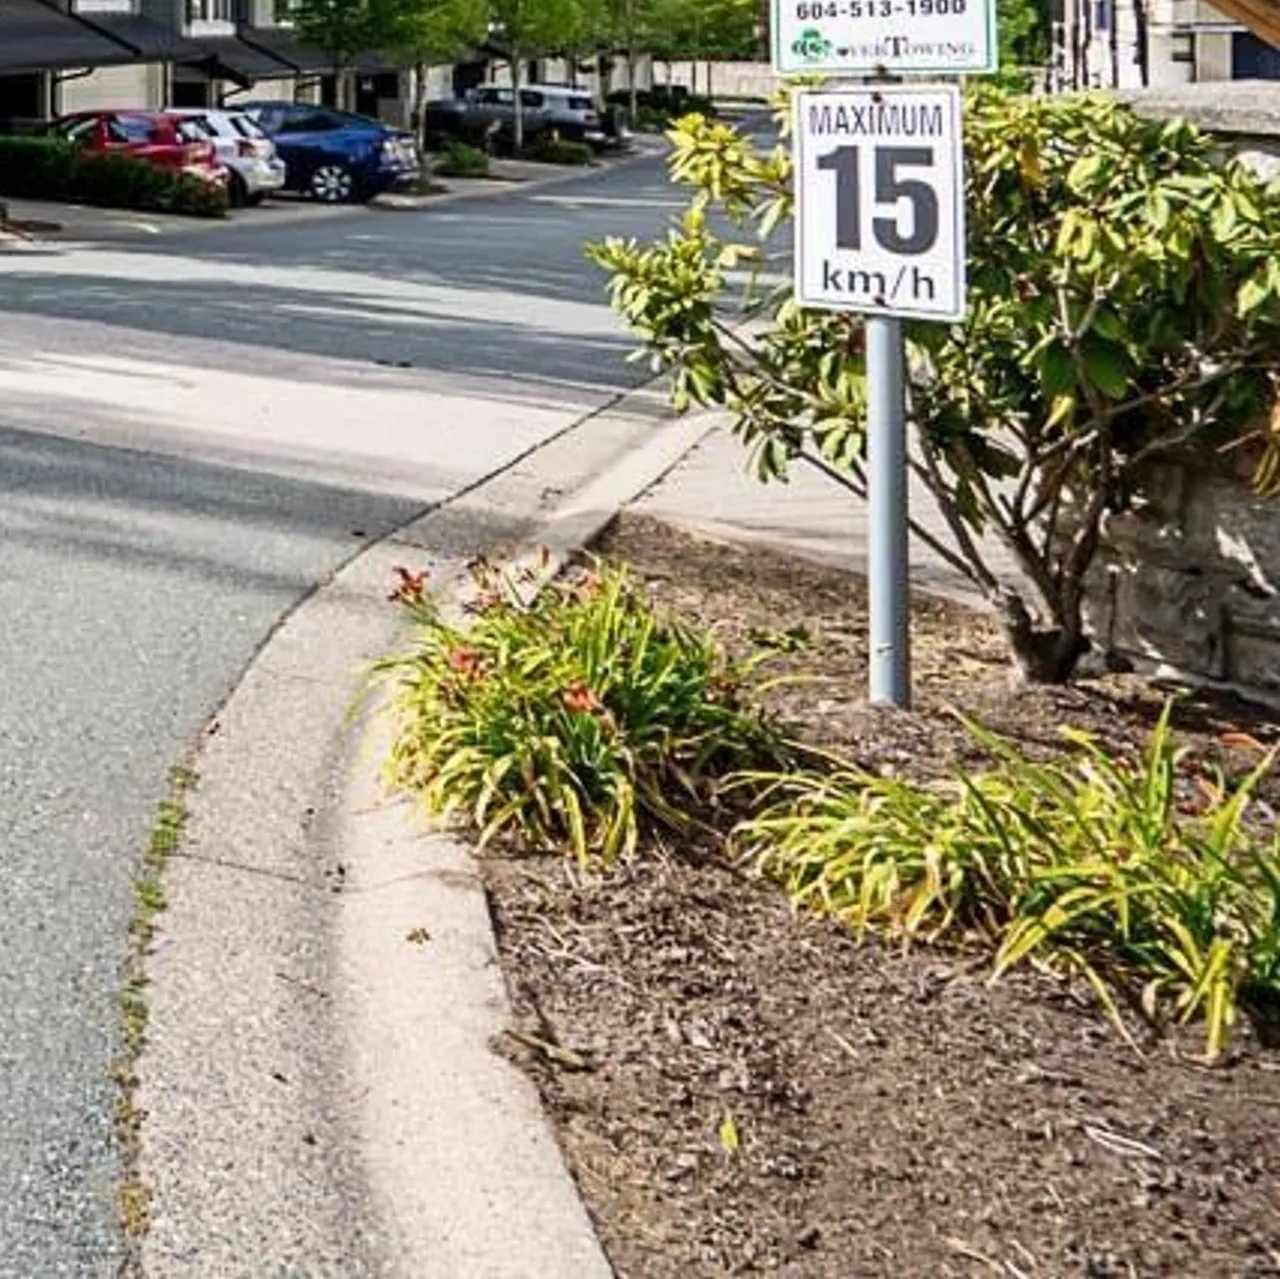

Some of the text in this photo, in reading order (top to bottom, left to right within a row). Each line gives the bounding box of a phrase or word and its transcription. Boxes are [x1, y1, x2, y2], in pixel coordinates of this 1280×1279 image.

[809, 104, 943, 136] MAXIMUM
[816, 145, 939, 255] 15
[823, 259, 935, 300] km/h
